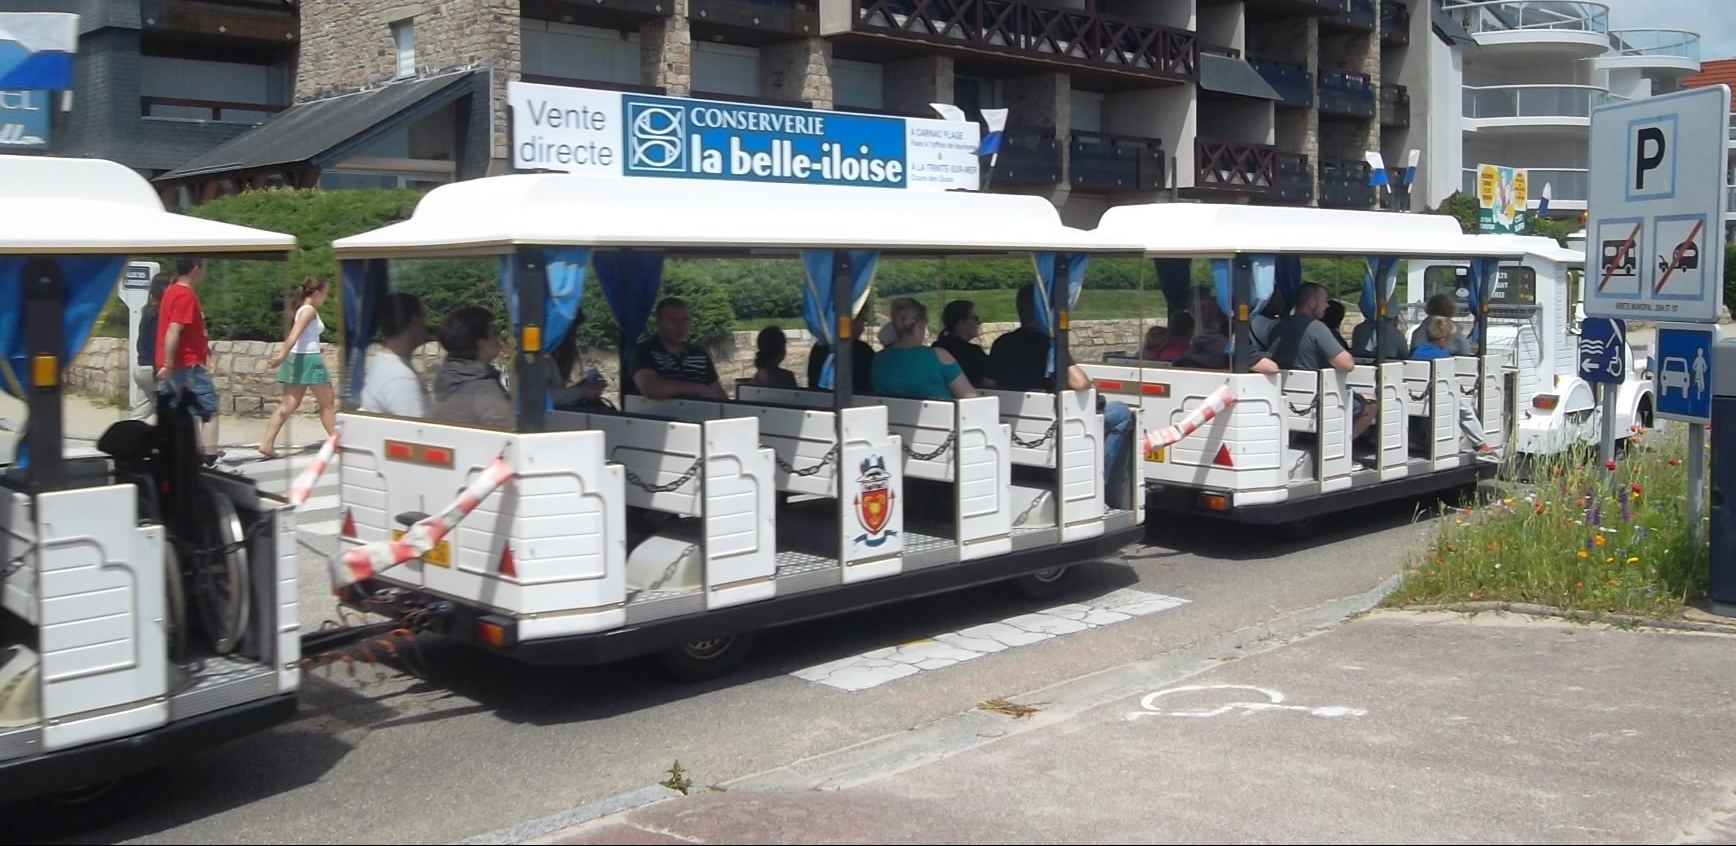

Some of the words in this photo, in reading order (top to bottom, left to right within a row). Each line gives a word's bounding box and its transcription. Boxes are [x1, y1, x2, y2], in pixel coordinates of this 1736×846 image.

[527, 99, 607, 131] Vente
[690, 107, 825, 135] CONSERVERIE
[519, 136, 614, 166] directe
[691, 133, 723, 174] la
[730, 136, 903, 182] belle-iloise
[1636, 127, 1666, 190] P
